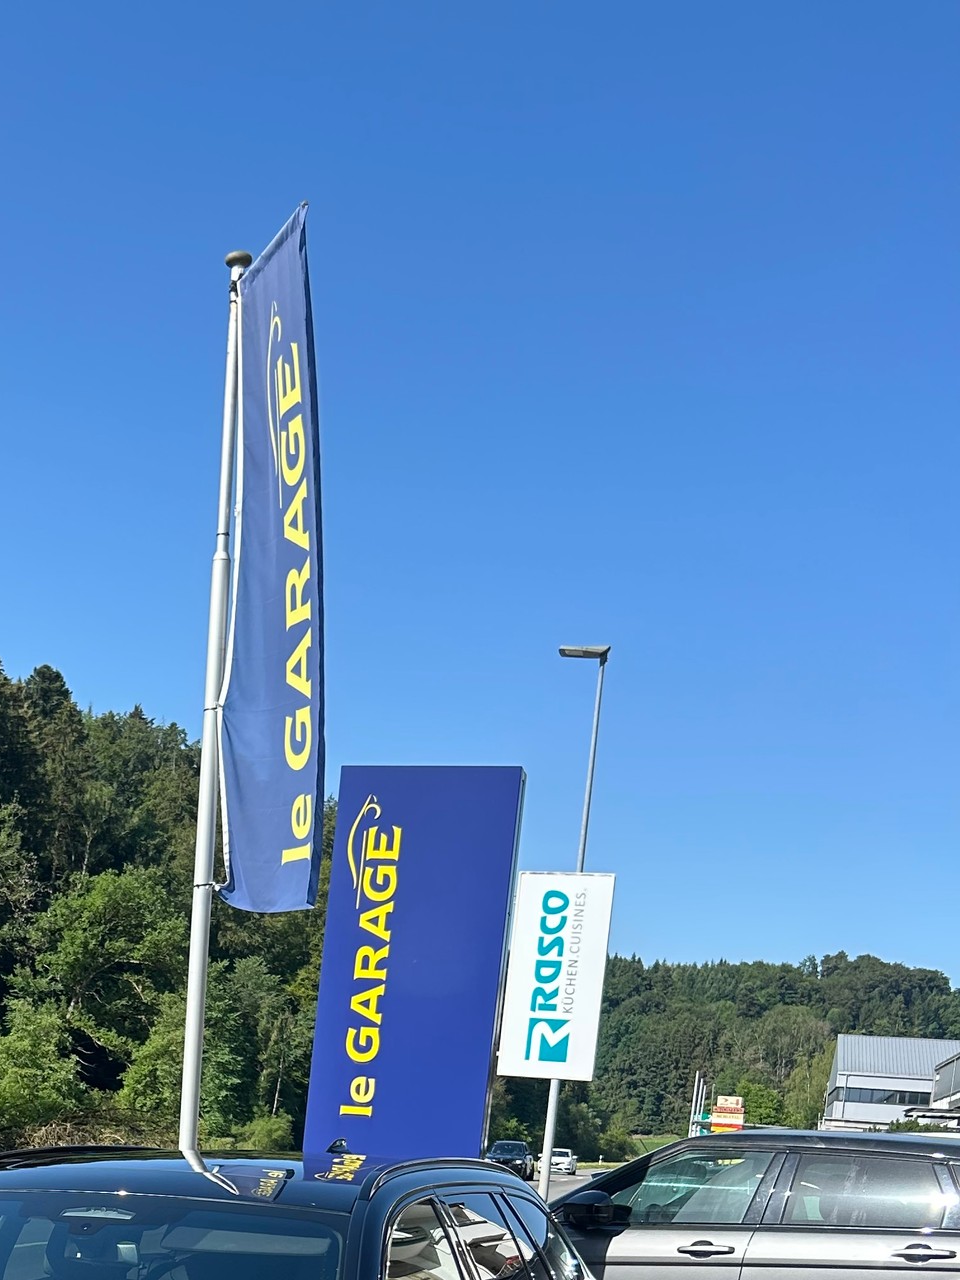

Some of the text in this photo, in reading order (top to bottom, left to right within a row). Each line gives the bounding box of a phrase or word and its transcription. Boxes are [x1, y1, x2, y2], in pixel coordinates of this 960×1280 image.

[277, 342, 312, 865] le GARAGE
[345, 824, 403, 1063] GARAGE
[340, 1075, 376, 1118] le
